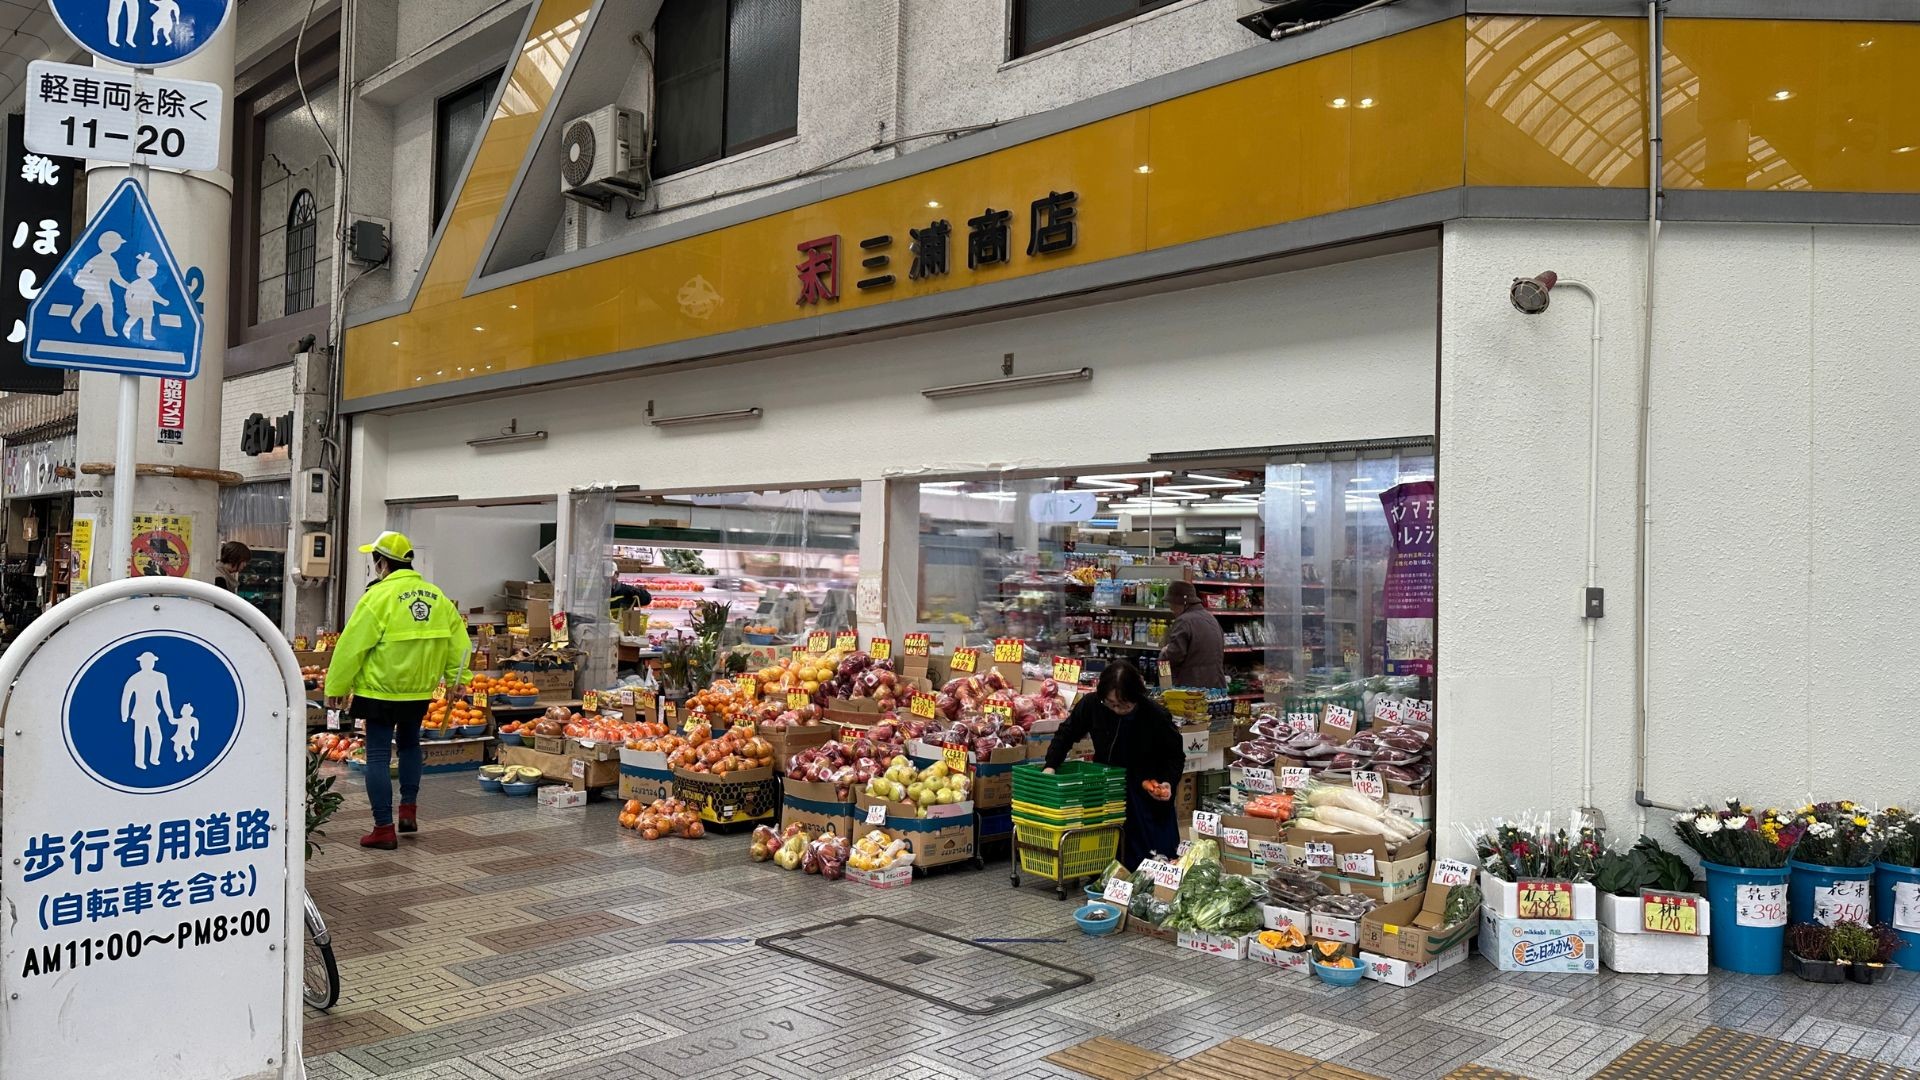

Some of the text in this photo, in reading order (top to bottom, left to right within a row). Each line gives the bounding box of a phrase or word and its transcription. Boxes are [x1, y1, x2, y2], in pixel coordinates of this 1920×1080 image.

[40, 73, 208, 121] 軽車両を除く
[857, 190, 1079, 290] 三浦商店
[162, 379, 182, 426] 防犯カメラ
[160, 428, 182, 440] 作動中
[1355, 770, 1378, 782] 大根
[24, 808, 272, 882] 歩行者用道路
[38, 864, 258, 930] (自転車を含む)
[1527, 883, 1563, 891] 奉仕品
[1521, 901, 1558, 917] ¥498
[1750, 903, 1782, 921] 398
[1832, 903, 1864, 923] 350
[1647, 915, 1680, 931] ¥120
[1524, 937, 1574, 964] 三ヶ日みかん
